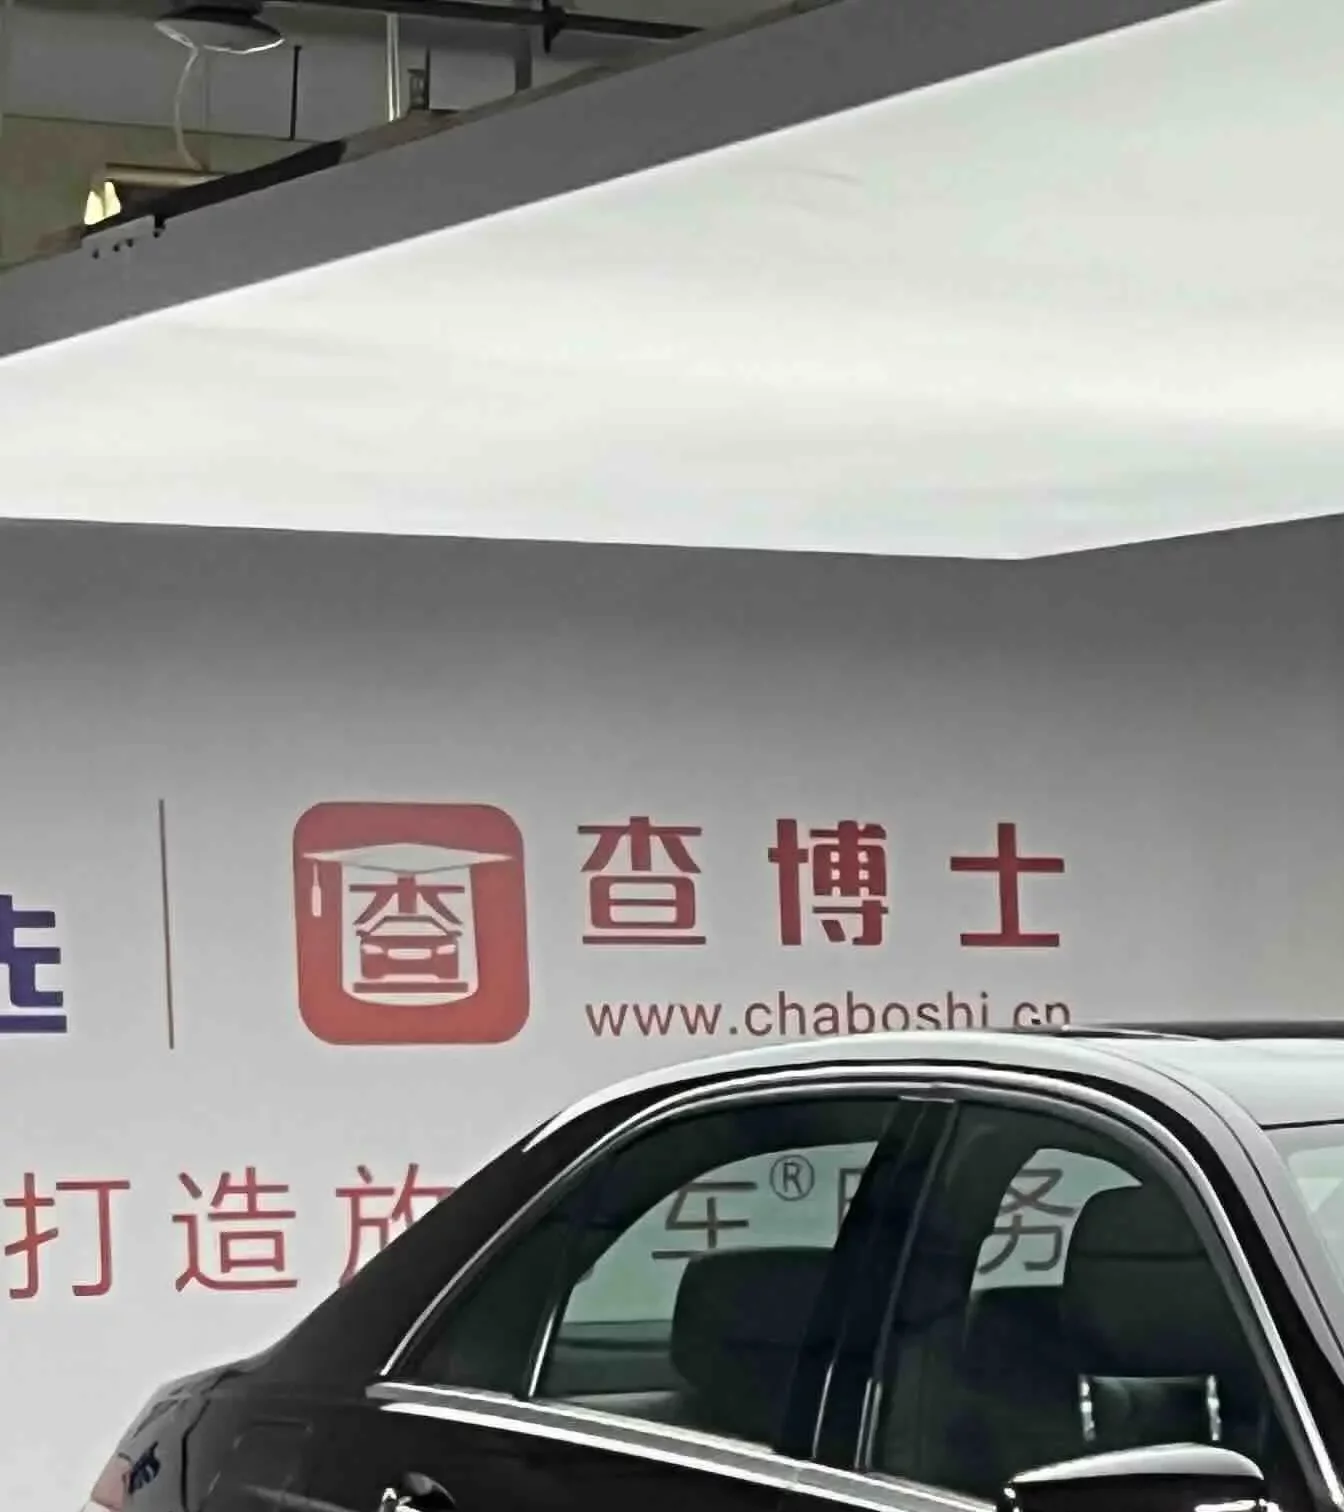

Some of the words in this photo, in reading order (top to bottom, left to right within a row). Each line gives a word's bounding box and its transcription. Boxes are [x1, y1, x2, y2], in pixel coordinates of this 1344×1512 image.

[577, 815, 1065, 948] 查博士
[585, 990, 1070, 1036] www.chaboshicn
